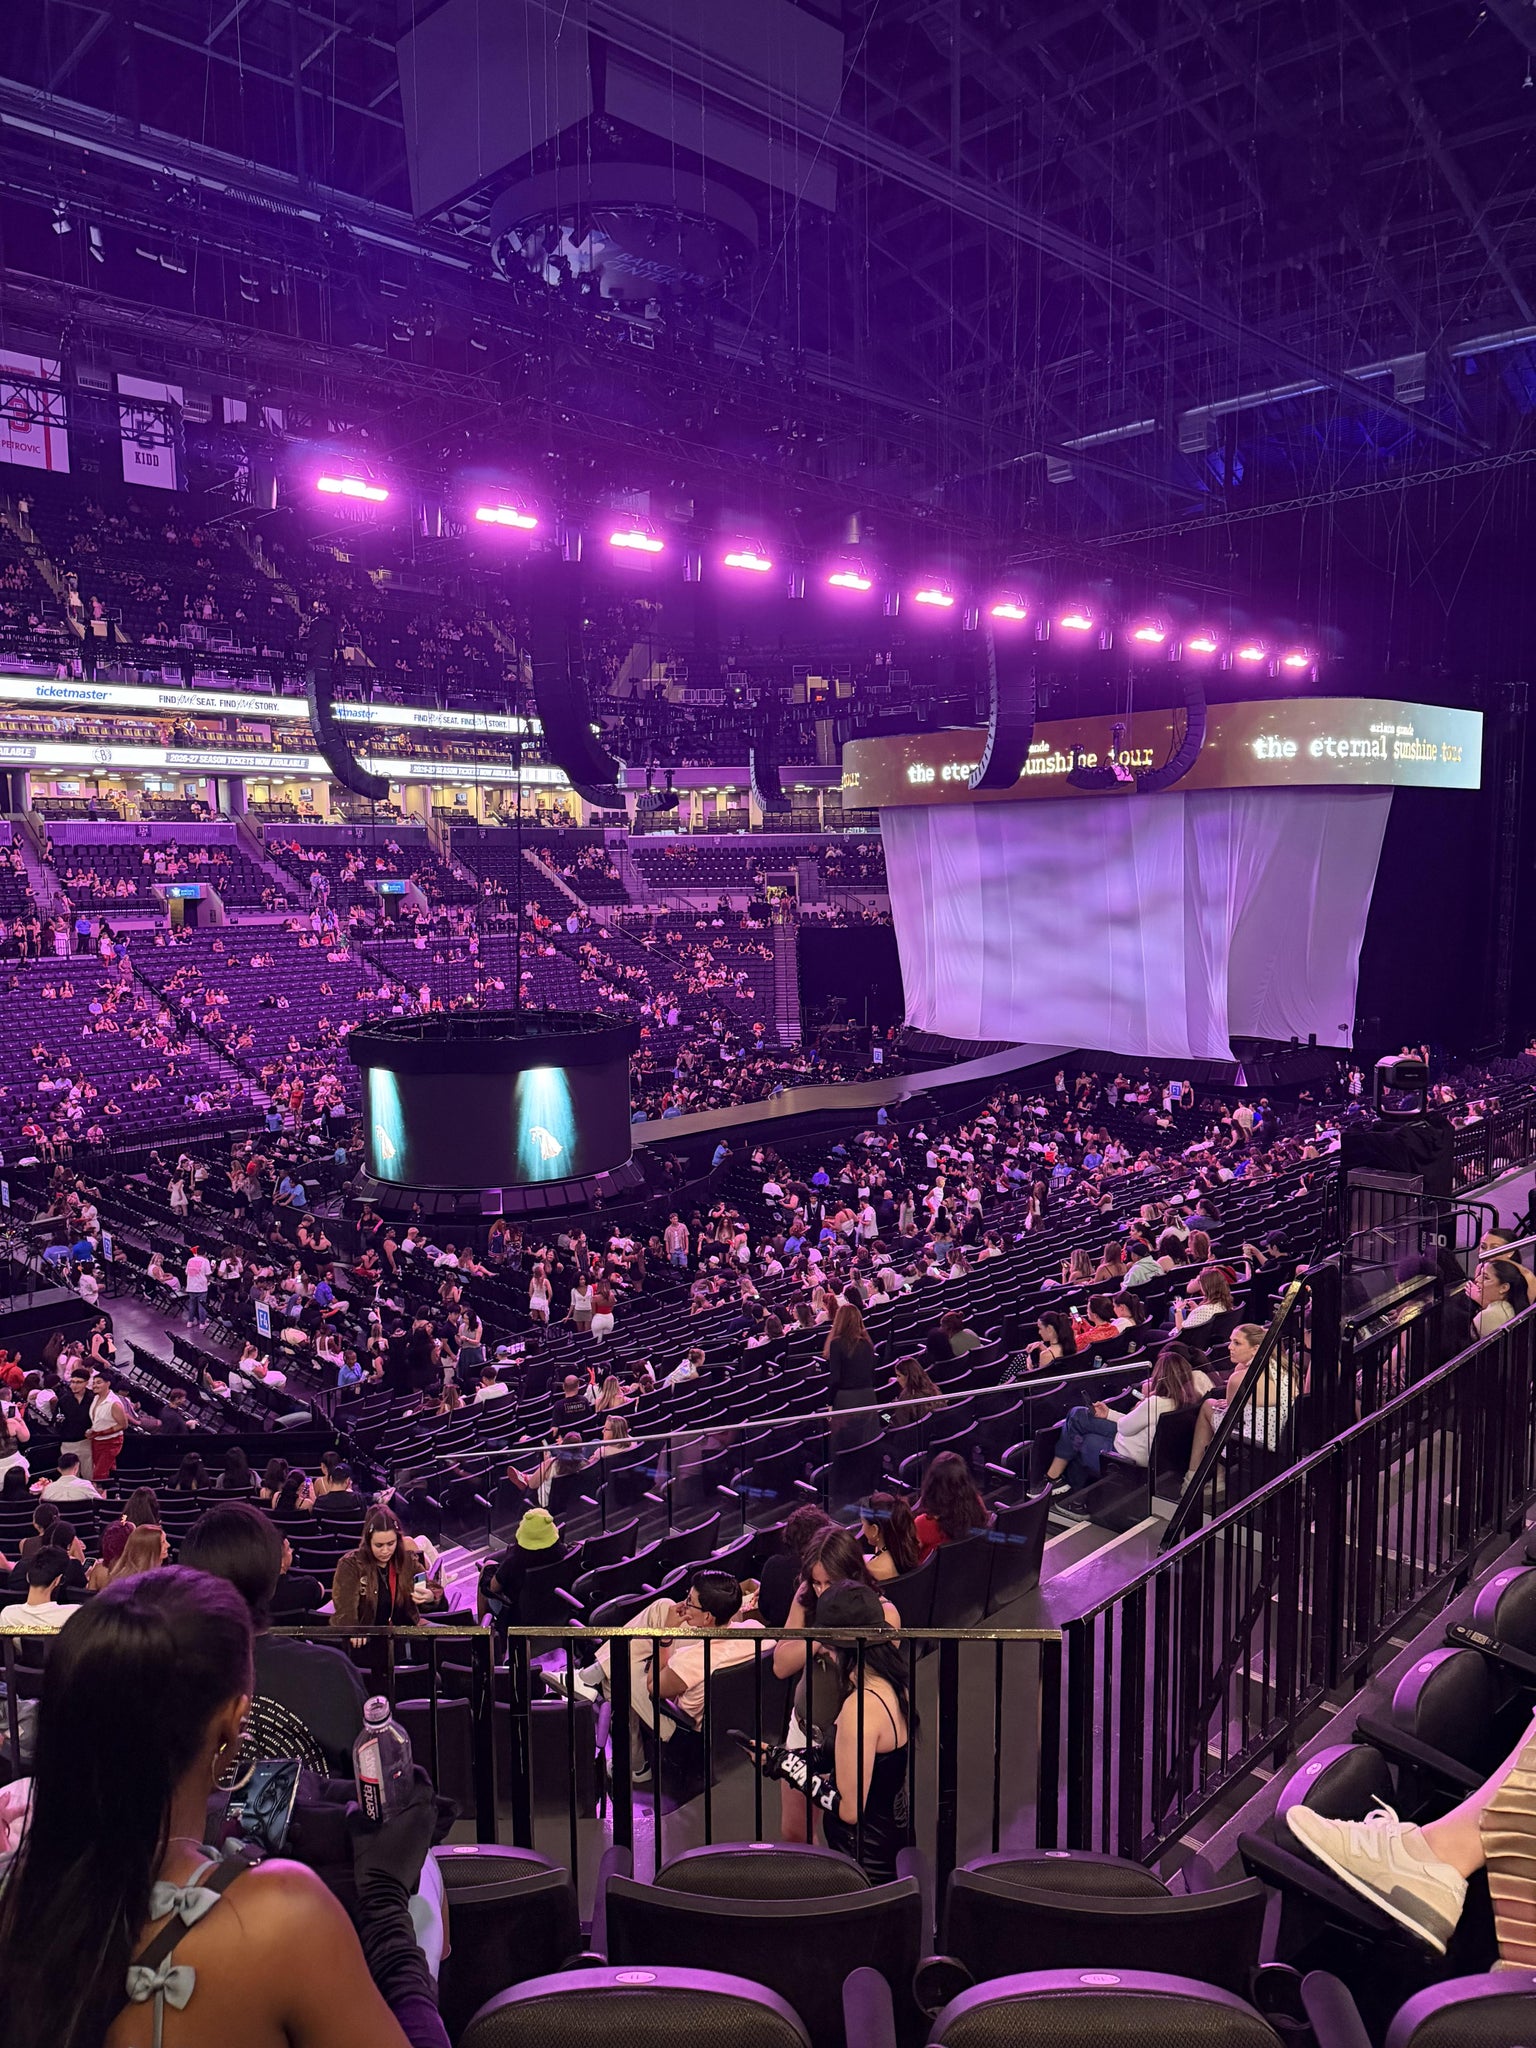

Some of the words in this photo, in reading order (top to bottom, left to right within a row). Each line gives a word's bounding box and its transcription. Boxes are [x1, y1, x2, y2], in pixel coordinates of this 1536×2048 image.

[1, 439, 41, 454] PETROVIC
[134, 451, 159, 467] KIDD
[36, 685, 108, 700] ticketmaster
[158, 694, 176, 704] FIND
[196, 698, 217, 707] SEAT.
[219, 699, 237, 708] FIND
[255, 702, 280, 712] STORY.
[413, 713, 428, 723] FIND
[1252, 734, 1298, 759] the
[1310, 735, 1388, 760] eternal
[1393, 737, 1438, 761] sunshine
[199, 754, 226, 765] SEASON
[227, 755, 254, 766] TICKETS
[254, 757, 270, 767] NOW
[270, 757, 306, 768] AVAILABLE
[907, 763, 935, 783] the
[259, 1311, 269, 1329] F4
[363, 1784, 376, 1821] sentia
